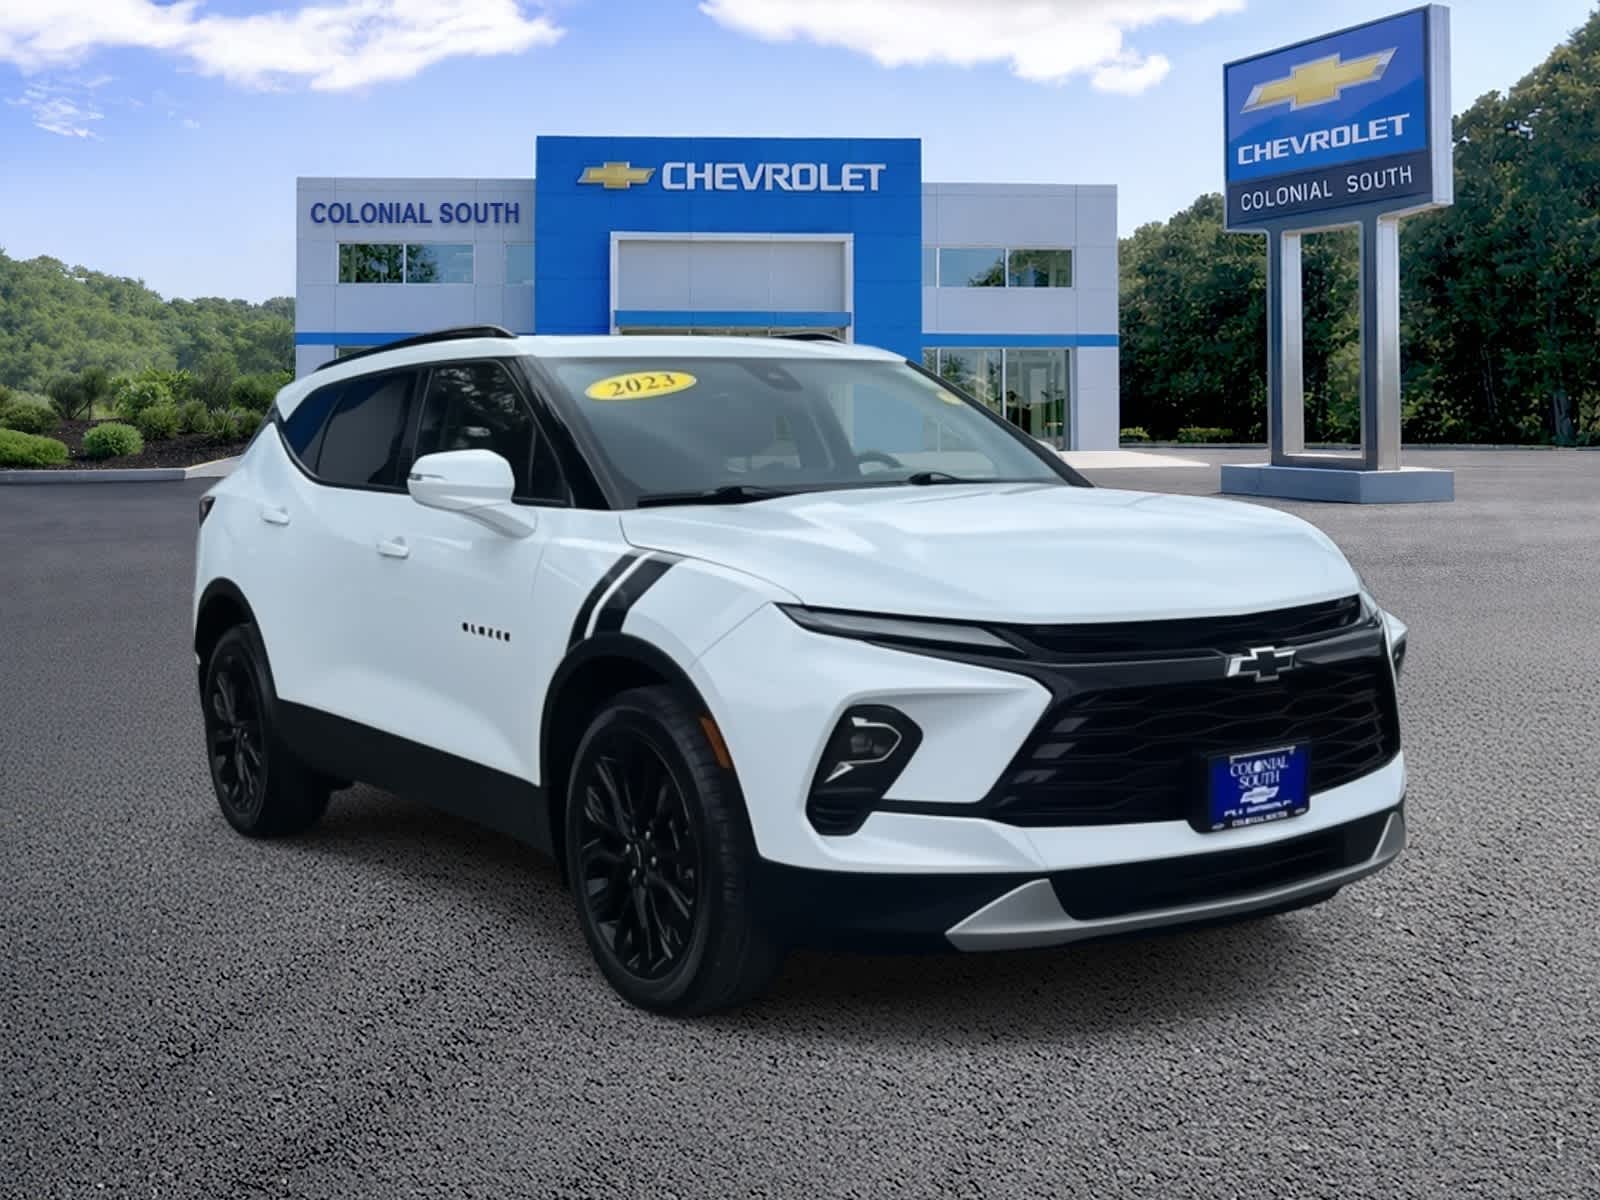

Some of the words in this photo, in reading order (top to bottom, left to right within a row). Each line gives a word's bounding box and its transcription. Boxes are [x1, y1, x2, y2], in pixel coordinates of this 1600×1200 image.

[1238, 113, 1410, 165] CHEVROLET
[662, 162, 887, 192] CHEVROLET
[1241, 179, 1333, 212] COLONIAL
[1347, 165, 1413, 194] SOUTH
[310, 202, 433, 224] COLONIAL
[439, 202, 520, 224] SOUTH
[609, 373, 677, 397] 2023
[1230, 755, 1289, 777] COLONIAL
[1238, 769, 1280, 790] SOUTH
